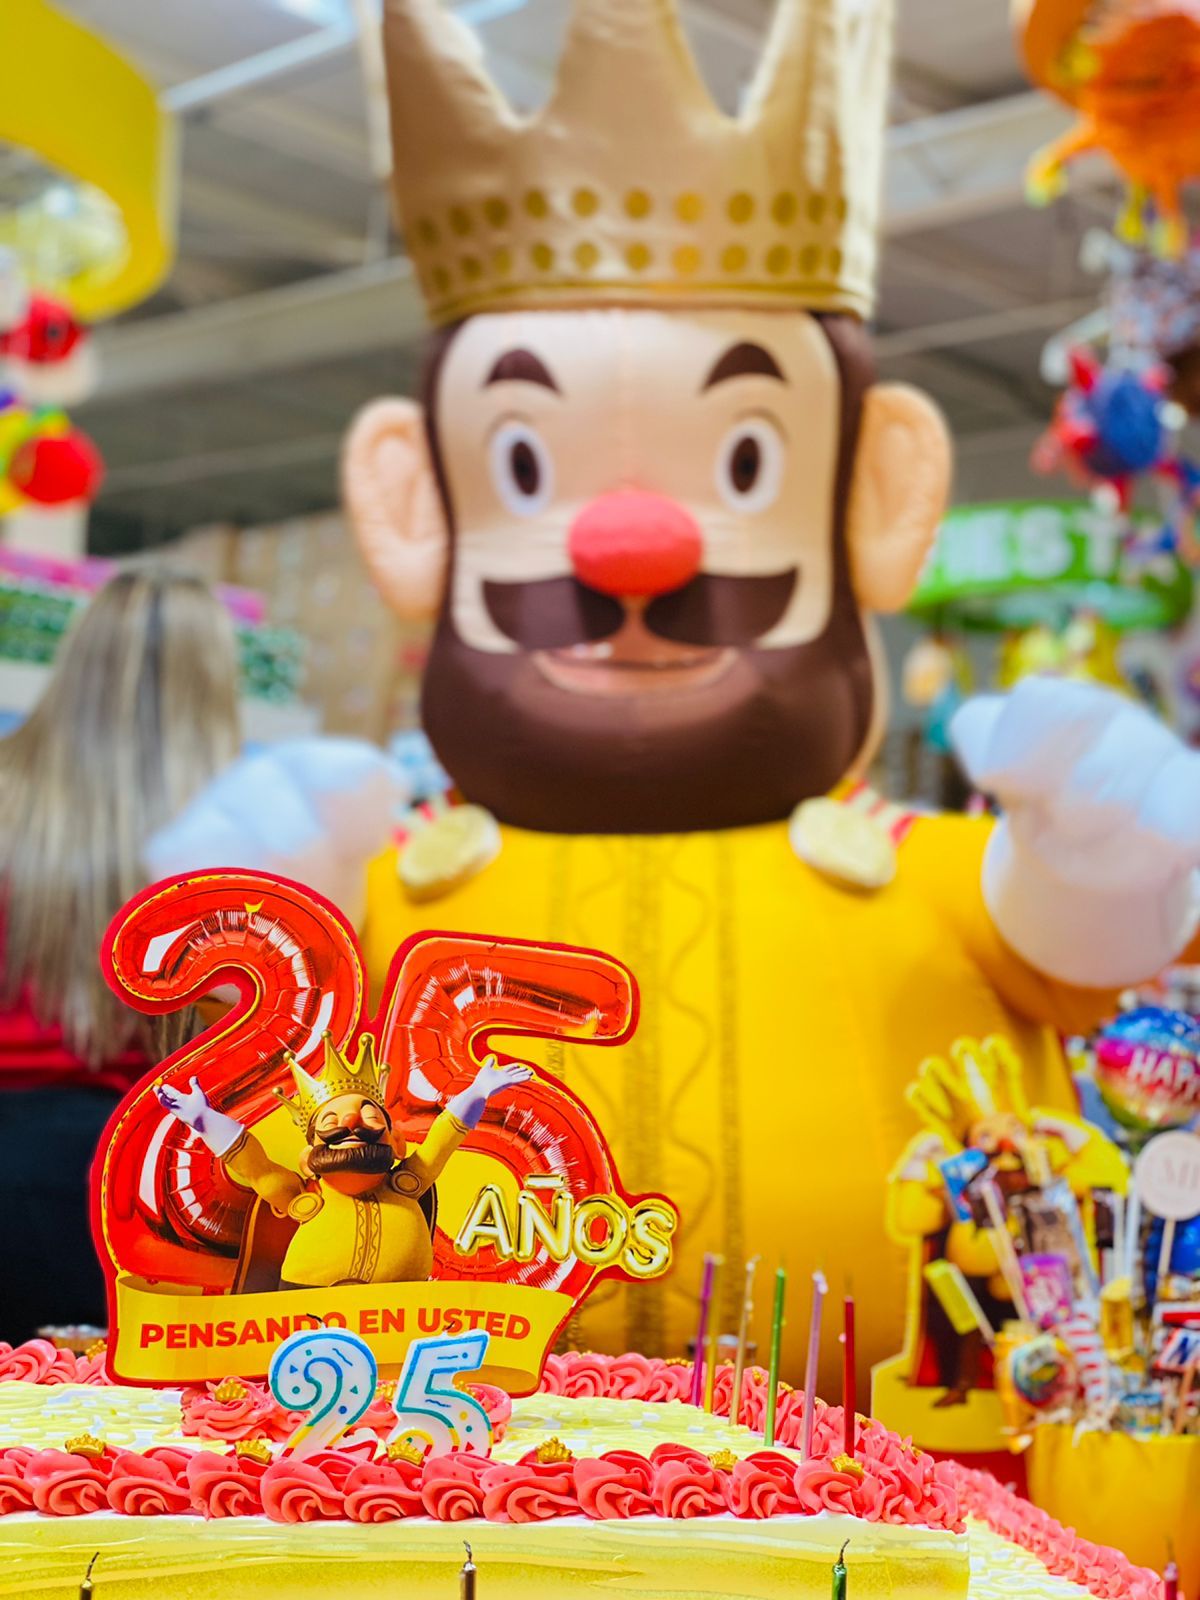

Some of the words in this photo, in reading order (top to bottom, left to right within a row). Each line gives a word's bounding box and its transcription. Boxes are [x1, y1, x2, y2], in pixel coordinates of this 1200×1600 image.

[98, 870, 636, 1292] 25
[454, 1173, 678, 1279] AÑOS
[139, 1311, 347, 1349] PENSANDO
[359, 1308, 406, 1334] EN
[417, 1307, 531, 1340] USTED
[269, 1328, 494, 1460] 25
